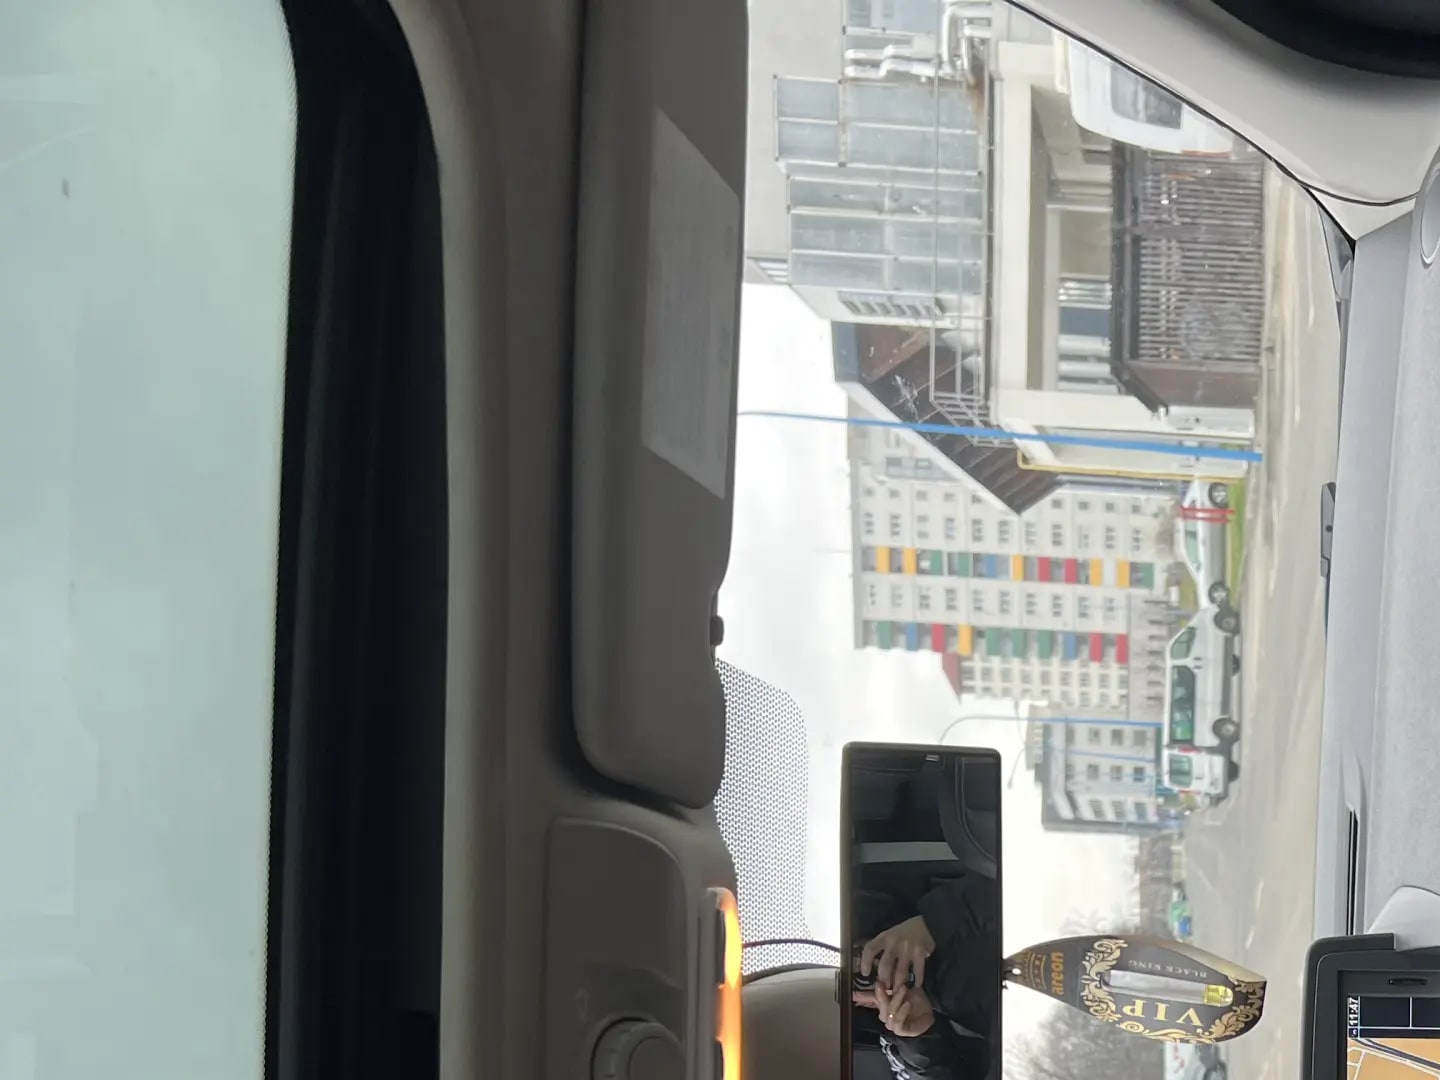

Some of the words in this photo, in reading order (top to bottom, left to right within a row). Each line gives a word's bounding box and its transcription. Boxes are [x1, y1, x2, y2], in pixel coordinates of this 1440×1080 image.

[1051, 951, 1064, 995] areon
[1128, 959, 1161, 970] KING
[1165, 965, 1207, 978] BLACK
[1122, 999, 1204, 1026] VIP
[1349, 997, 1358, 1025] 11:47
